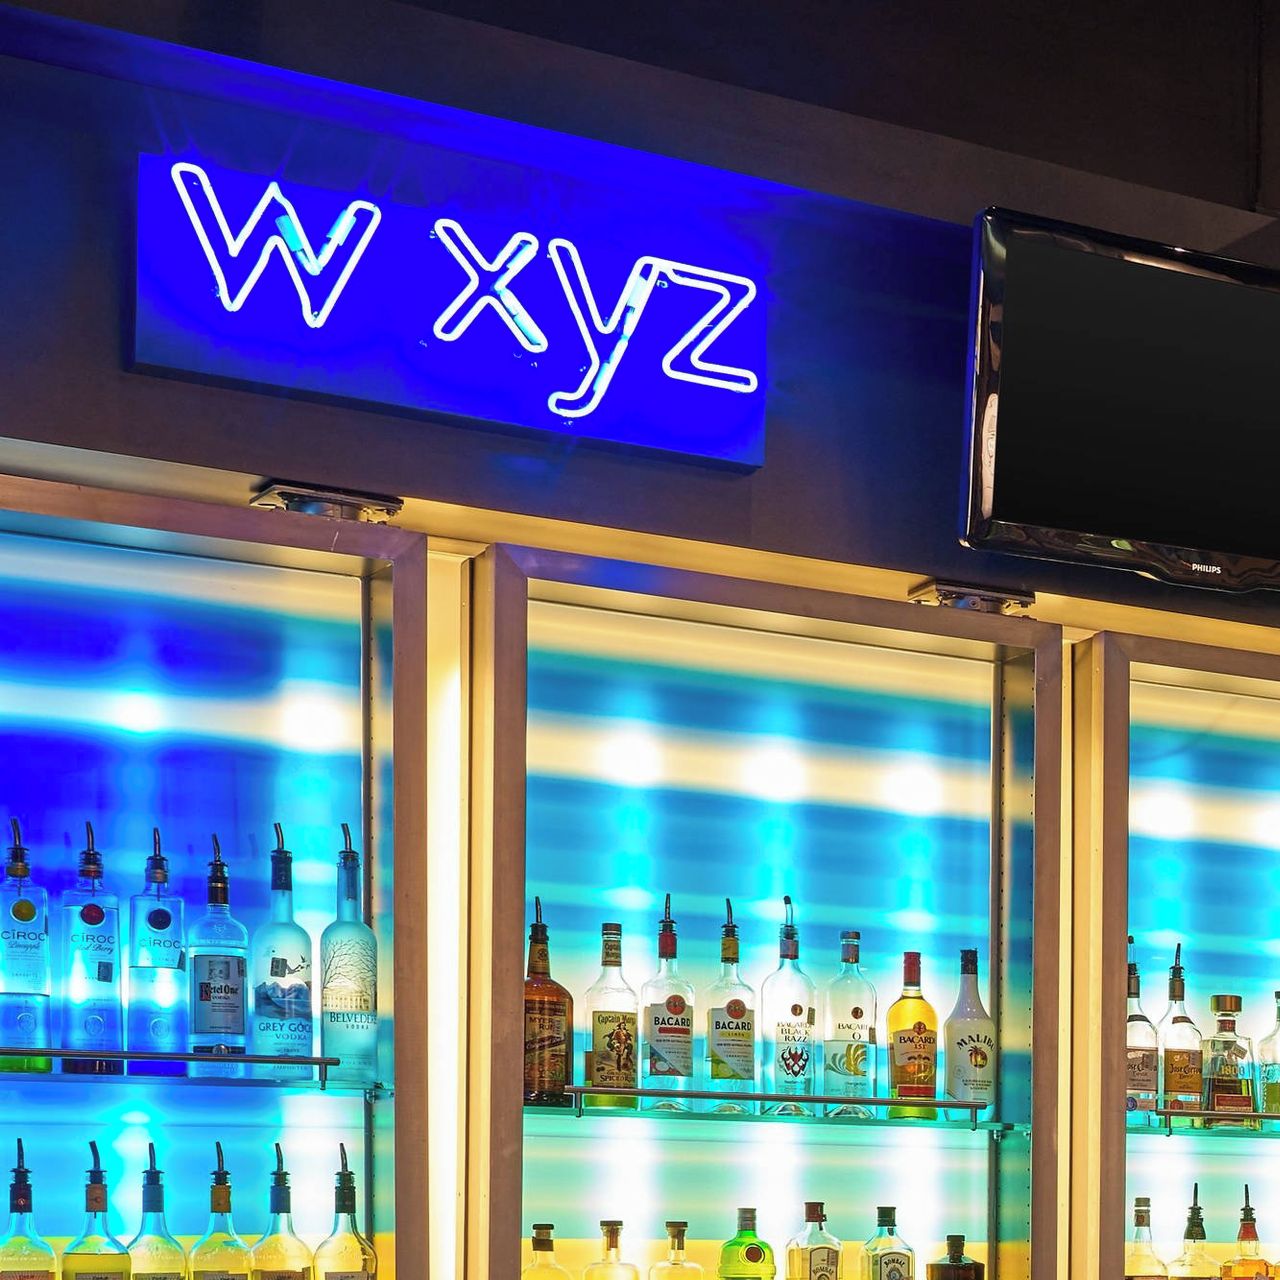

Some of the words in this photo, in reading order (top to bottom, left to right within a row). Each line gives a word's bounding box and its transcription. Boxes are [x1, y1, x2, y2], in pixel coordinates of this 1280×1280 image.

[1192, 563, 1221, 574] PHILIPS
[224, 985, 239, 995] One
[598, 1014, 620, 1025] Captain
[259, 1022, 286, 1032] GREY
[780, 1027, 810, 1037] BLACK
[275, 1033, 307, 1041] VODKA
[784, 1035, 808, 1043] RAZZ
[852, 1031, 861, 1041] O
[1221, 1065, 1245, 1075] 1800
[884, 1258, 905, 1268] BOMBAY
[812, 1266, 834, 1276] BOMBAY
